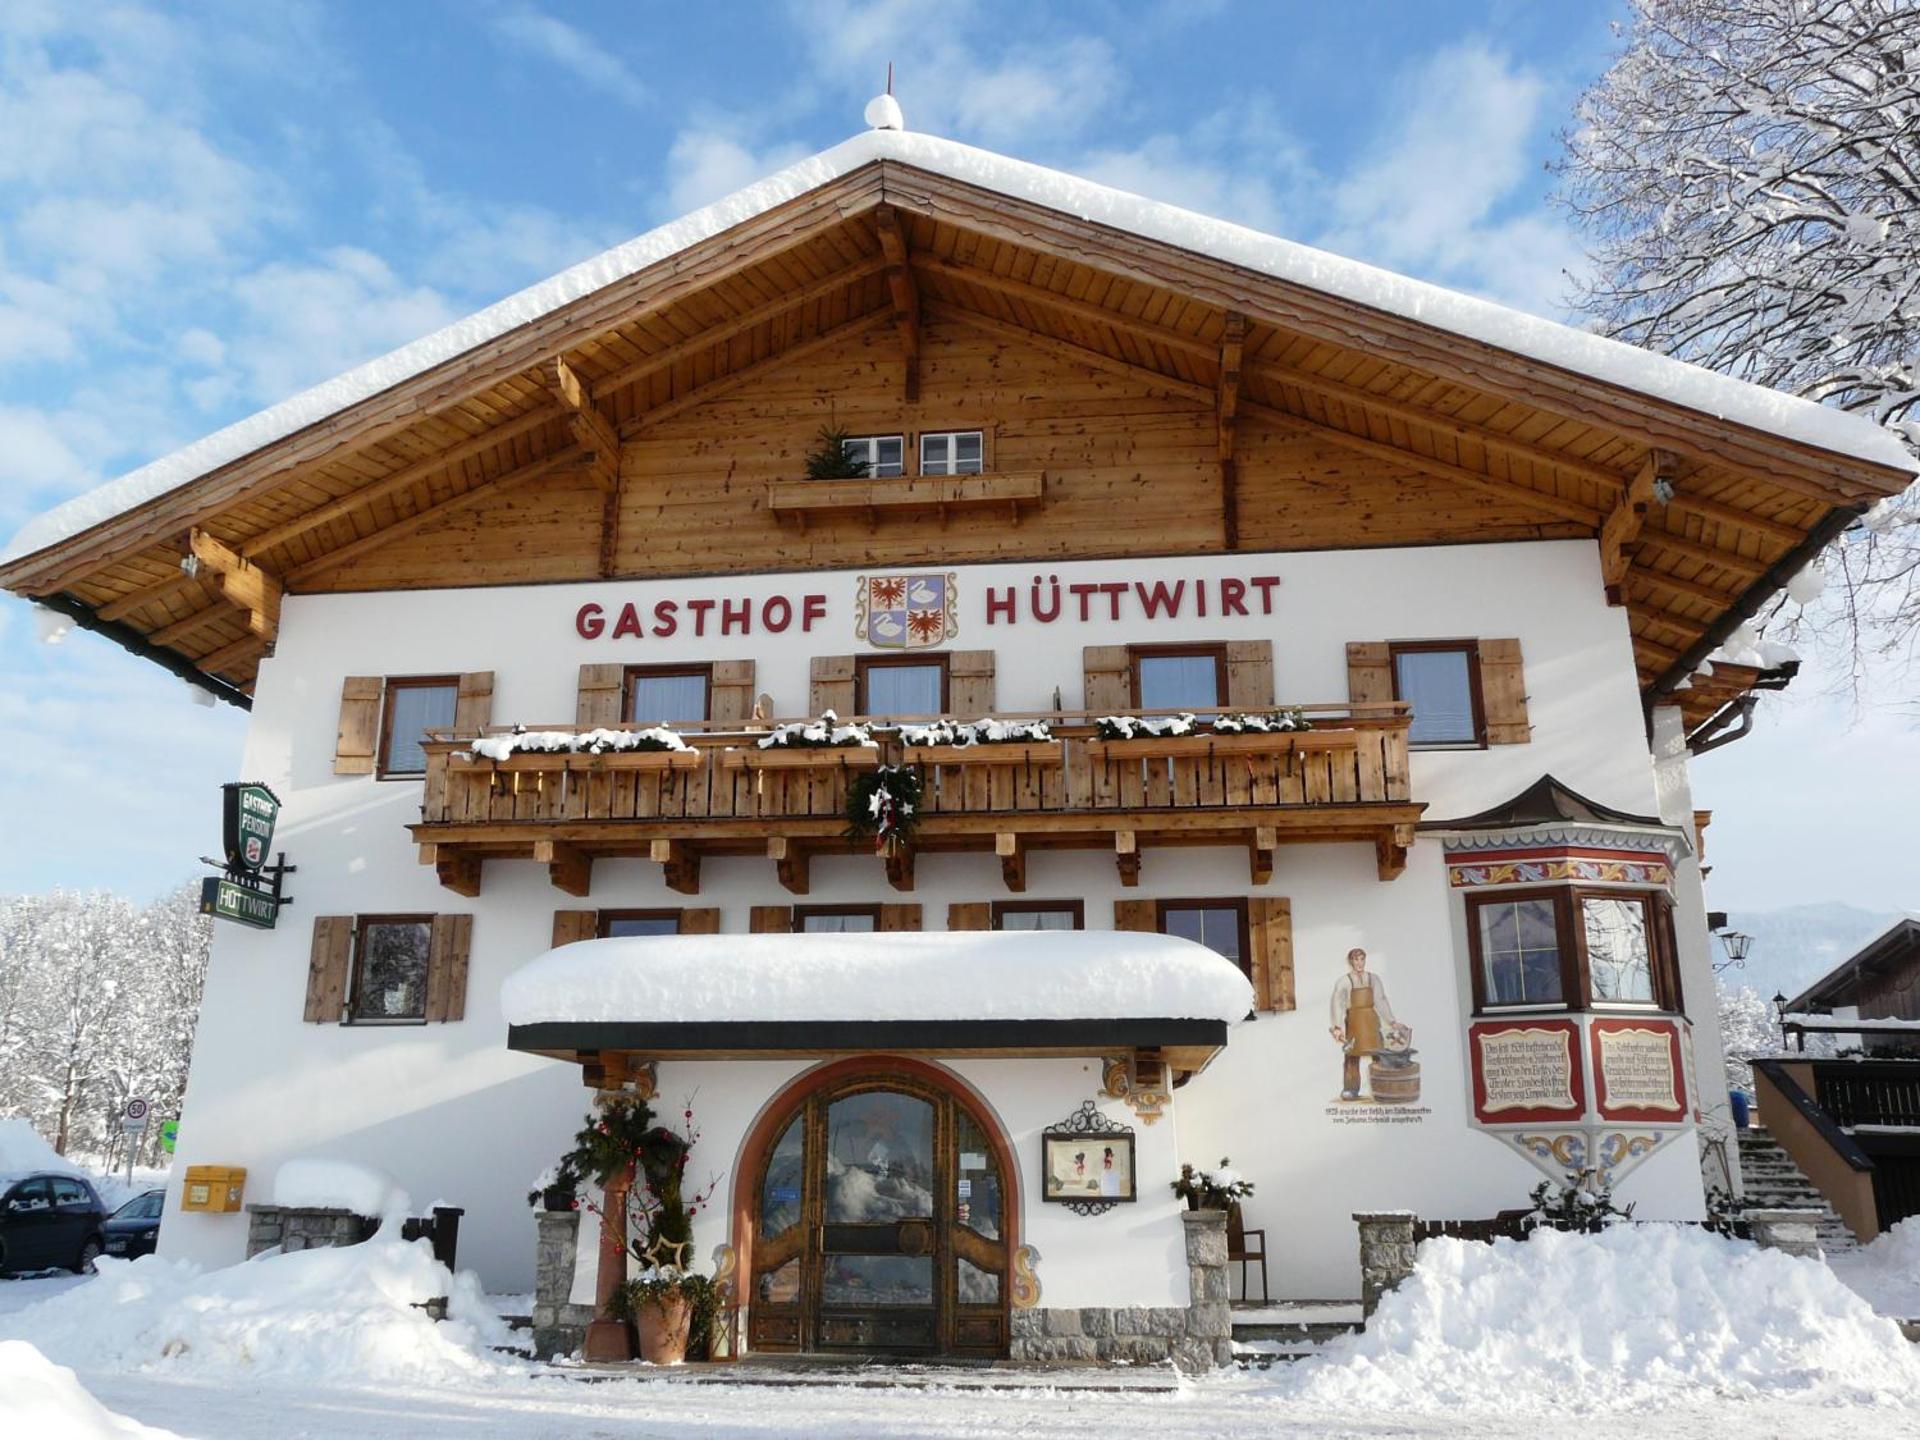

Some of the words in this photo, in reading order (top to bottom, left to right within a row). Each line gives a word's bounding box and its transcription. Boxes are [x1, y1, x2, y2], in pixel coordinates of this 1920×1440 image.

[575, 594, 828, 640] GASTHOF
[986, 574, 1281, 625] HÜTTWIRT
[241, 813, 272, 838] PENSION
[132, 1104, 143, 1114] 50
